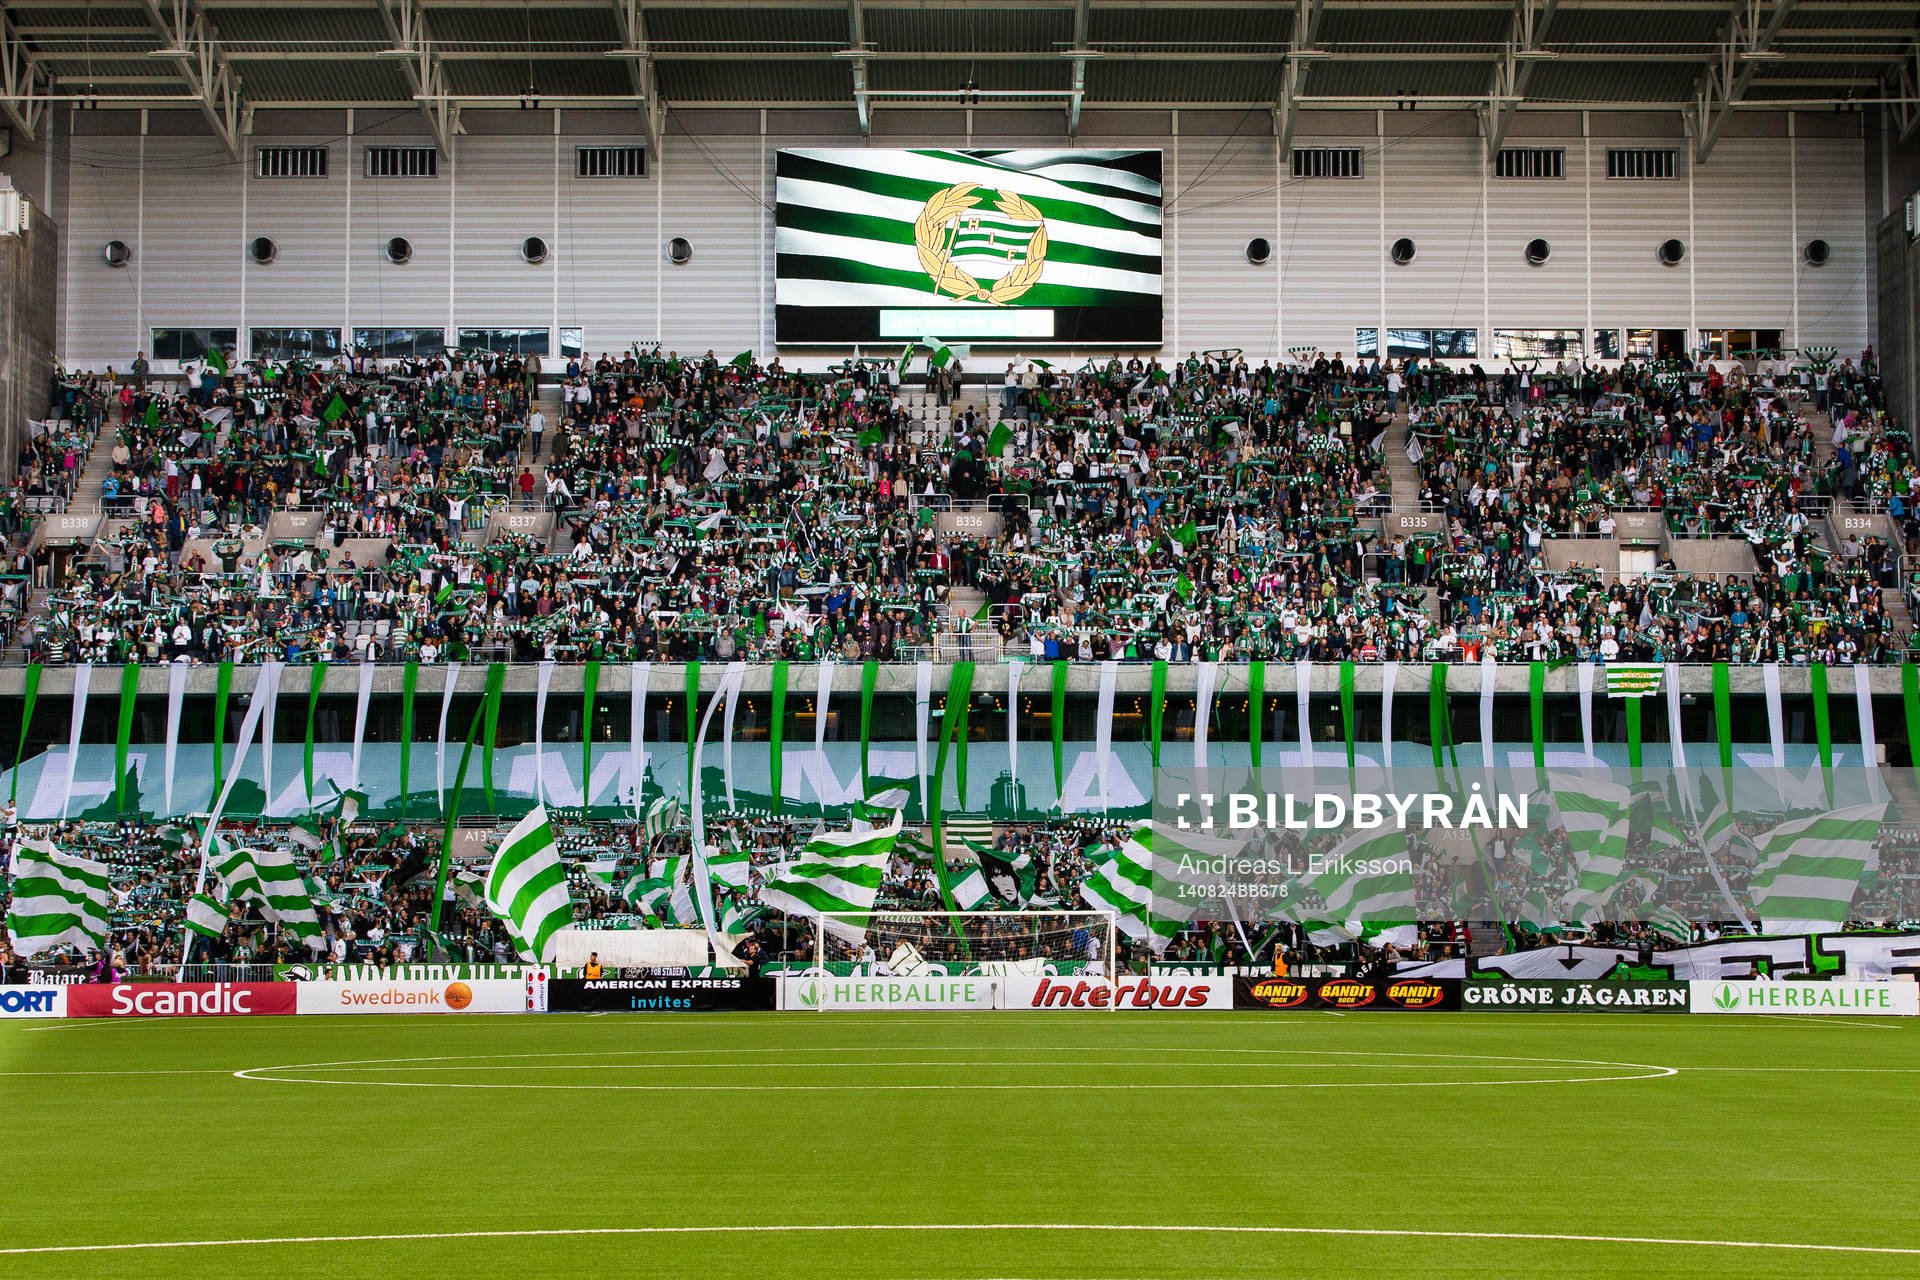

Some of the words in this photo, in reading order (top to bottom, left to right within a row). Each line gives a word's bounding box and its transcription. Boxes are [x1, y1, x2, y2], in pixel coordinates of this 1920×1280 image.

[61, 518, 89, 529] B338
[509, 516, 537, 527] B337
[955, 516, 983, 527] B336
[1400, 516, 1428, 528] B335
[1844, 518, 1872, 529] B334
[1442, 830, 1472, 841] A135
[583, 980, 667, 990] AMERICAN
[671, 979, 742, 989] EXPRESS
[340, 988, 440, 1005] Swedbank
[834, 983, 977, 1002] HERBALIFE
[1031, 978, 1211, 1007] Interbus
[1253, 985, 1306, 997] BANDIT
[1320, 985, 1373, 997] BANDIT
[1388, 986, 1441, 998] BANDIT
[1463, 983, 1554, 1005] GRÖNE
[1561, 984, 1688, 1006] JÄGAREN
[0, 990, 58, 1012] ORT
[111, 982, 252, 1015] Scandic
[631, 995, 692, 1009] invites
[1748, 987, 1891, 1008] HERBALIFE
